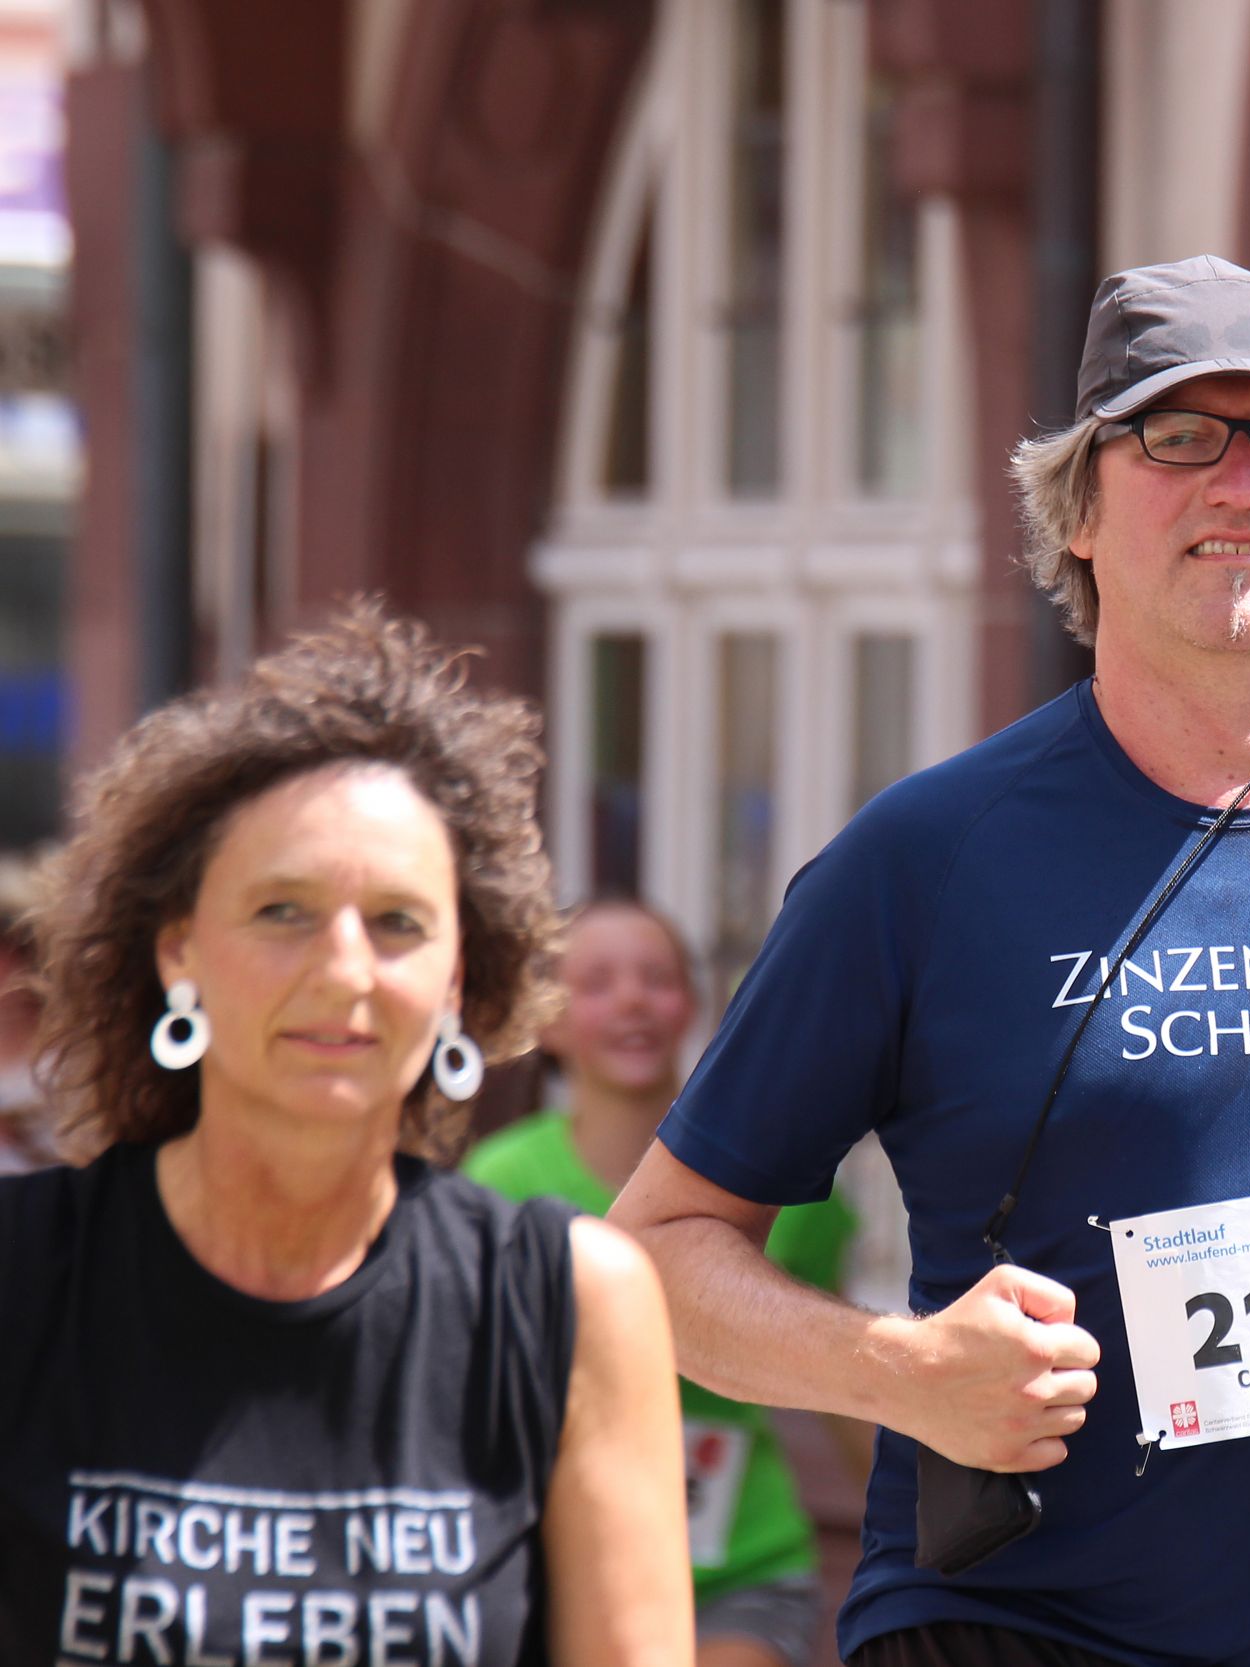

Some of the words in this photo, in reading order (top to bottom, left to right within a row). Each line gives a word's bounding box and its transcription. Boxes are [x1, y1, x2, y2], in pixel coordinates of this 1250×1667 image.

[1143, 1223, 1226, 1252] Stadtlauf
[68, 1494, 316, 1577] KIRCHE
[345, 1510, 476, 1576] NEU
[60, 1568, 481, 1667] ERLEBEN
